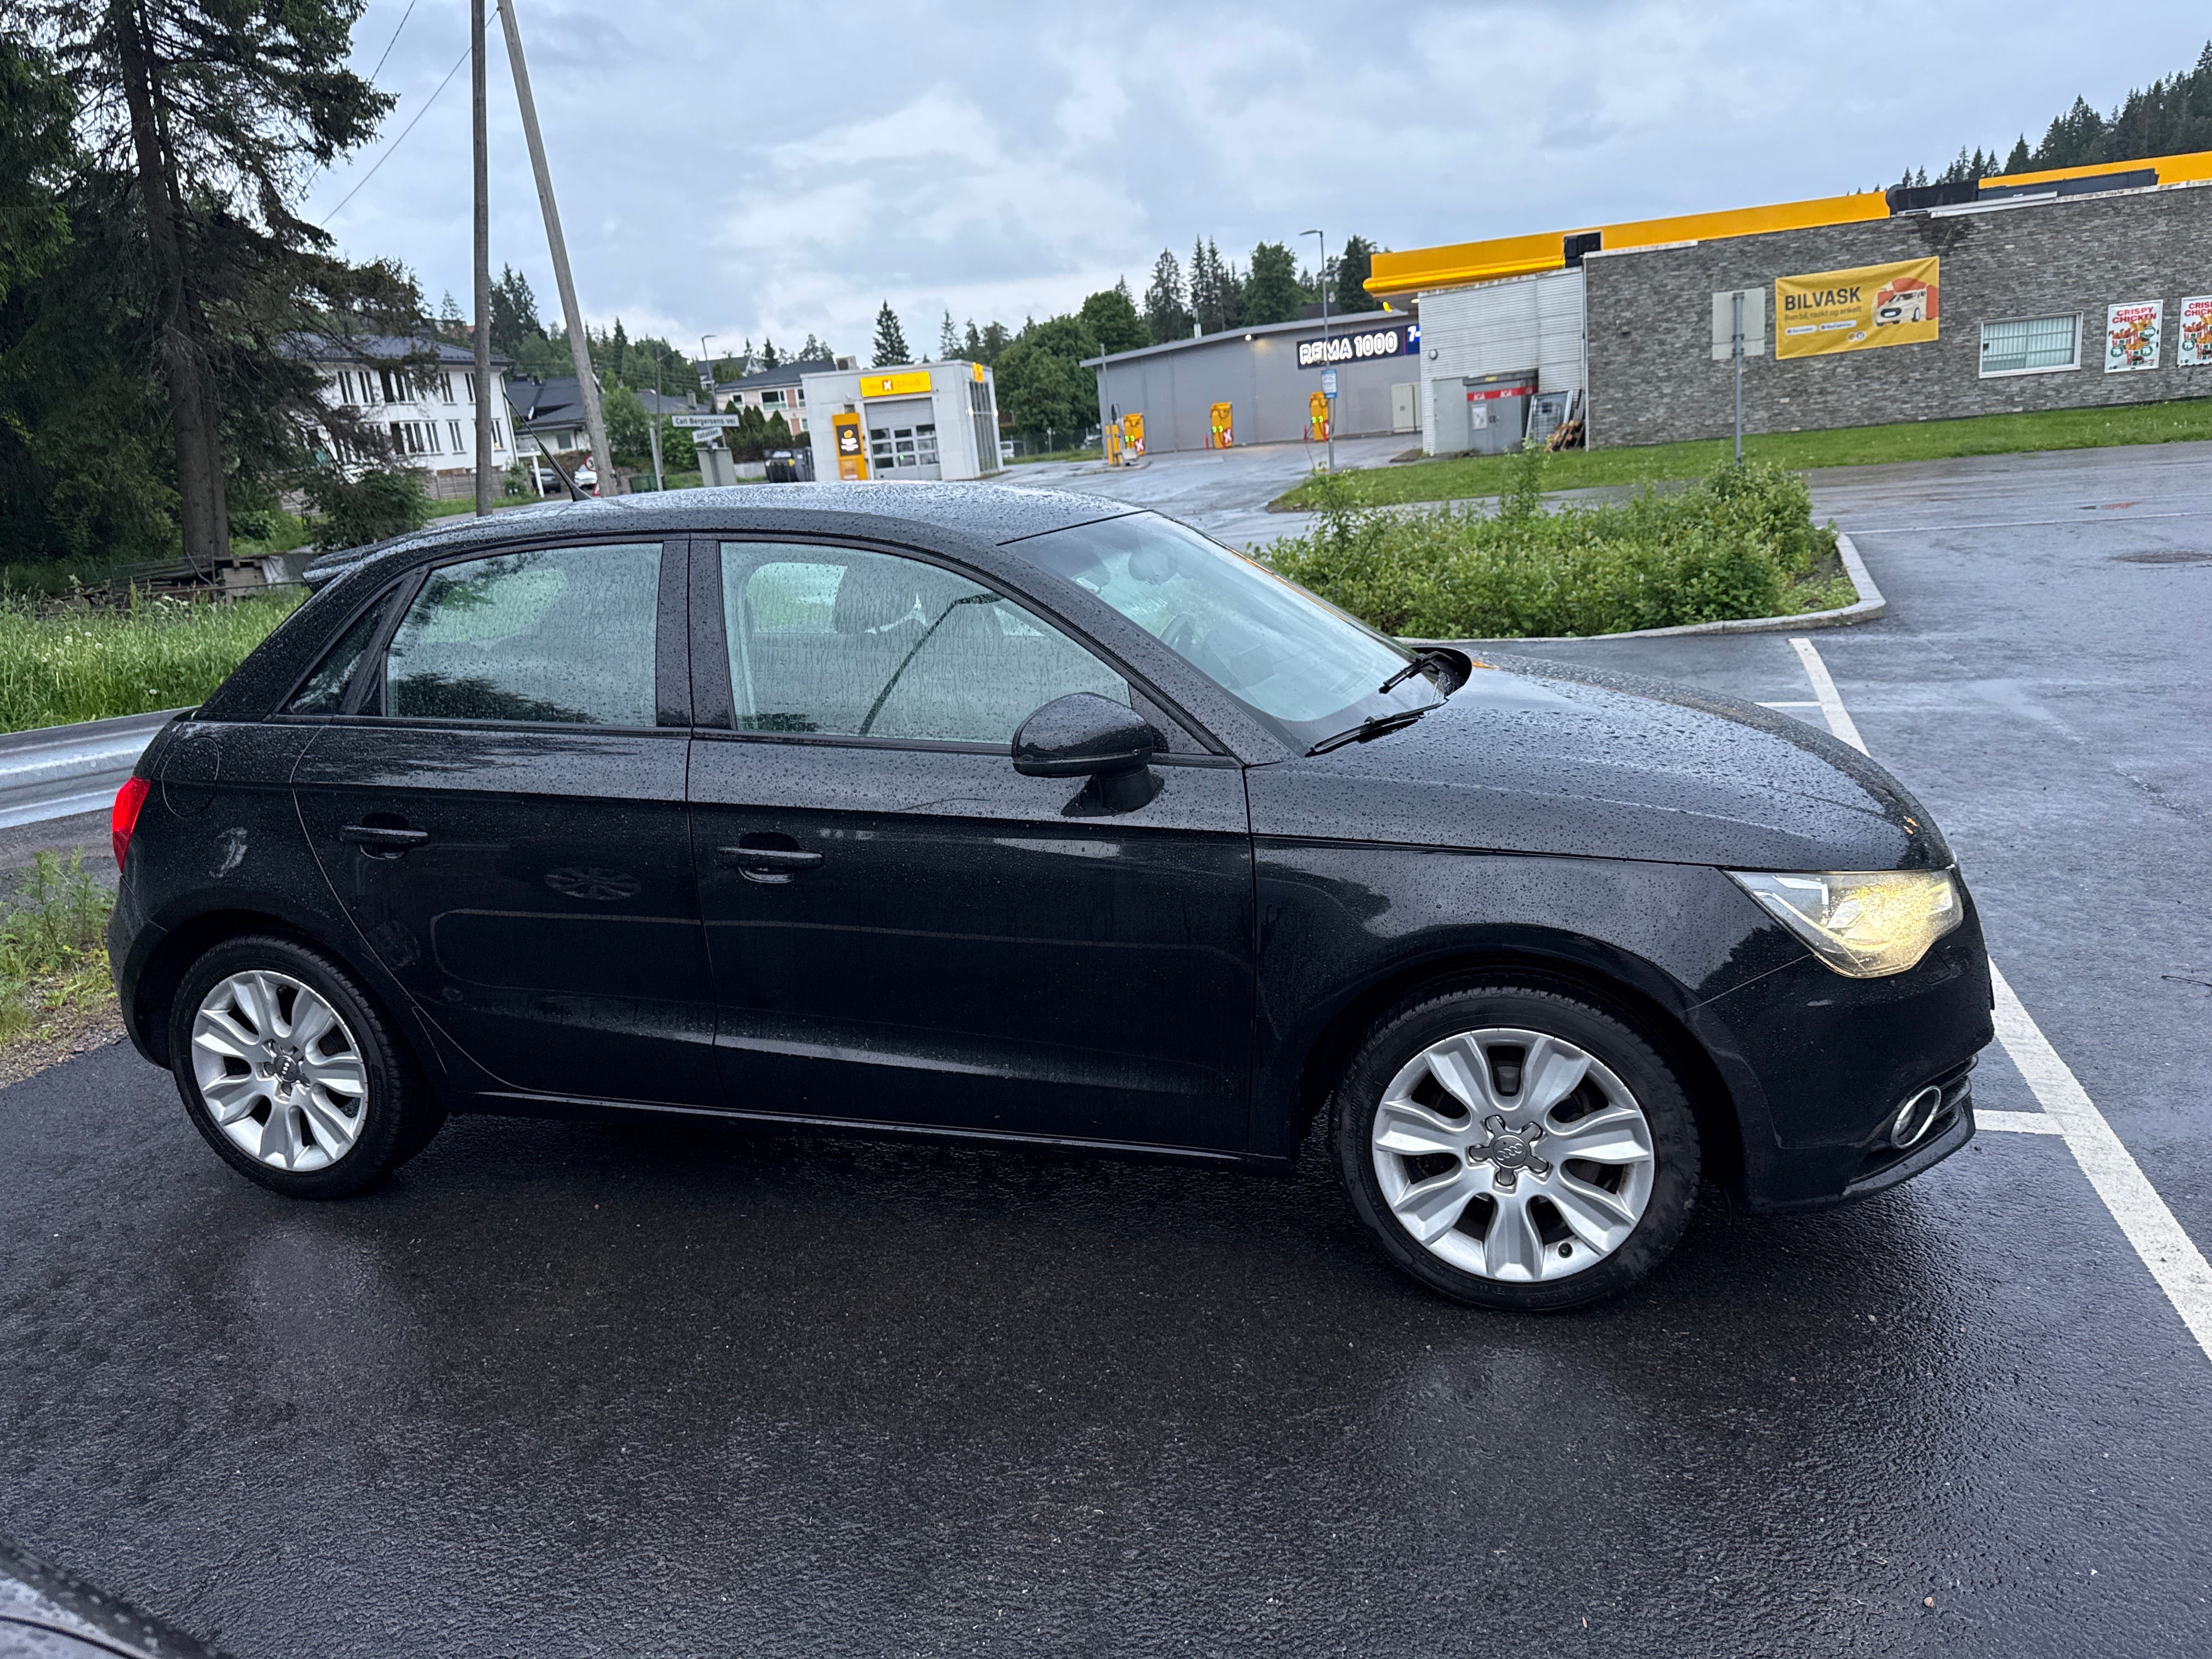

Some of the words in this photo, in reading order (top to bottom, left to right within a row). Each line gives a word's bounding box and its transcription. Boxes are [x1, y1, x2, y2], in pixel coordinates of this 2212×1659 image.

[1785, 286, 1861, 311] BILVASK
[2188, 301, 2212, 309] CRIS
[2117, 307, 2153, 316] CRISPY
[2112, 313, 2157, 323] CHICKEN
[1299, 338, 1352, 365] REMA
[1353, 331, 1397, 357] 1000
